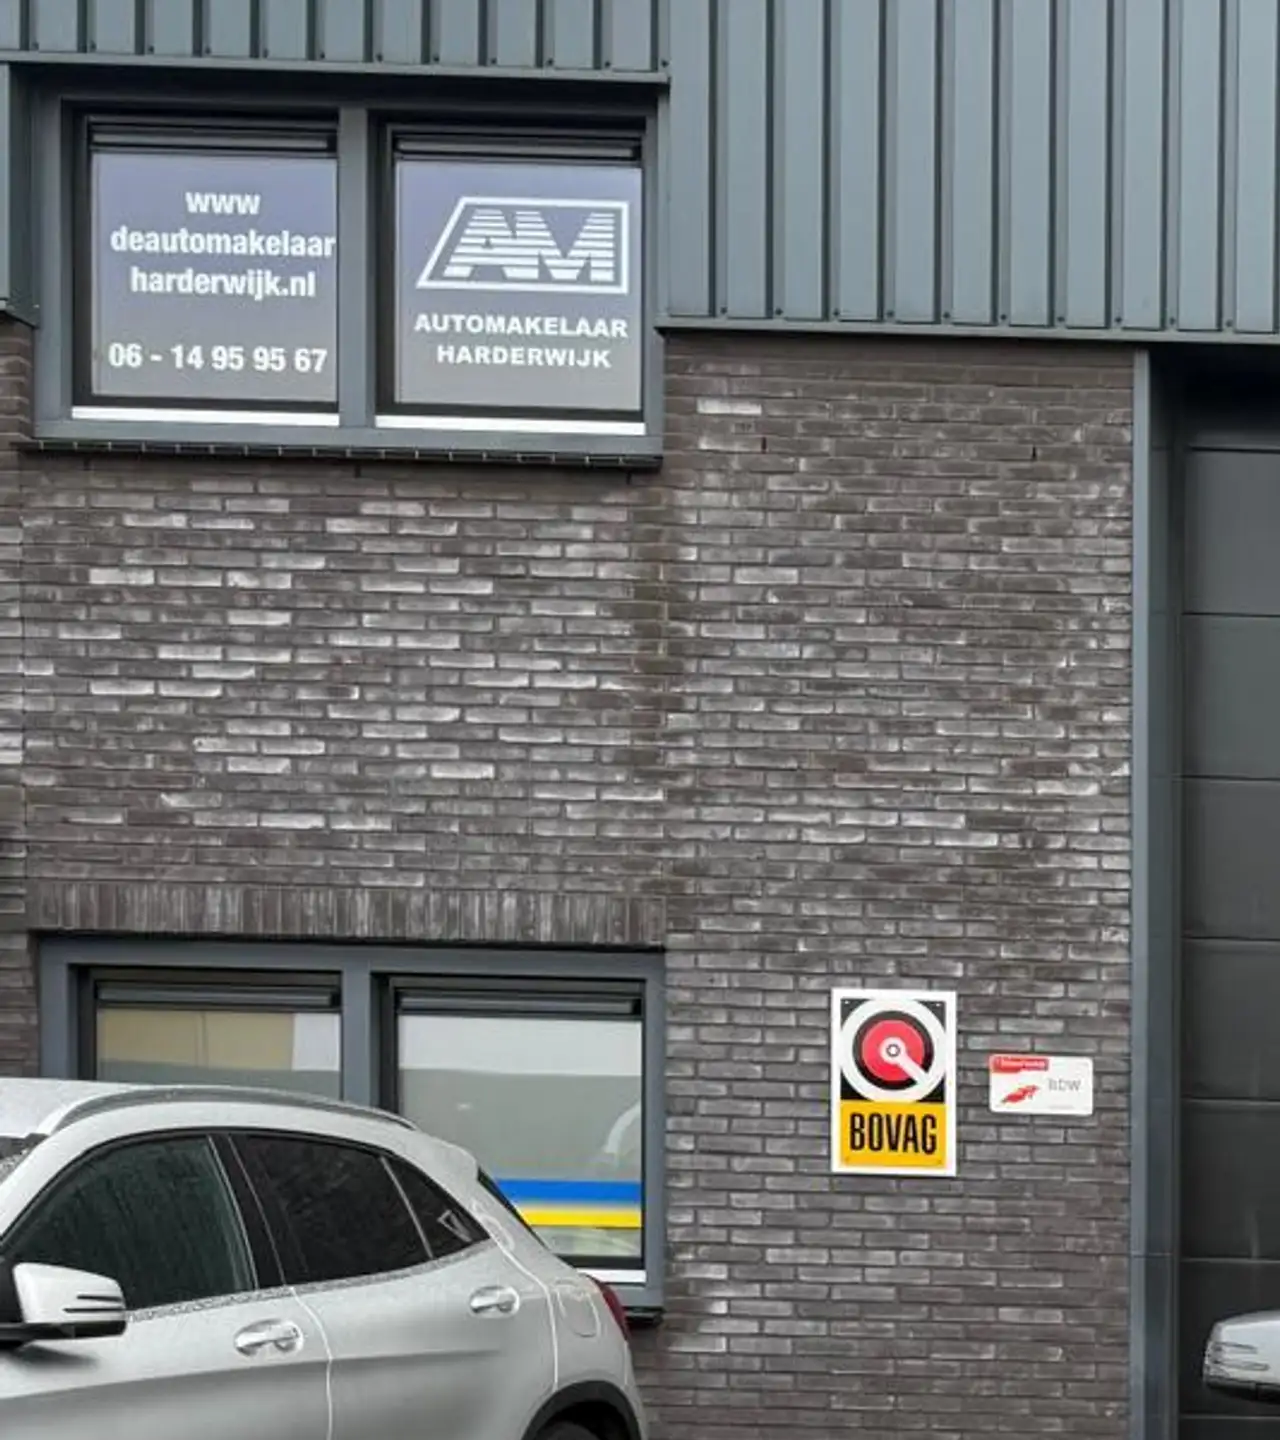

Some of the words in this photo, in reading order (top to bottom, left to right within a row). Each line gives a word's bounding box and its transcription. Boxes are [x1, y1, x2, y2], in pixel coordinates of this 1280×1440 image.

[185, 191, 261, 215] www
[110, 225, 336, 257] deautomakelaar
[131, 266, 317, 301] harderwijk.nl
[414, 313, 628, 337] AUTOMAKELAAR
[108, 343, 143, 368] 06
[171, 345, 204, 369] 14
[211, 345, 244, 371] 95
[253, 346, 287, 372] 95
[294, 348, 328, 373] 67
[437, 345, 612, 368] HARDERWIJK
[849, 1112, 937, 1155] BOVAG
